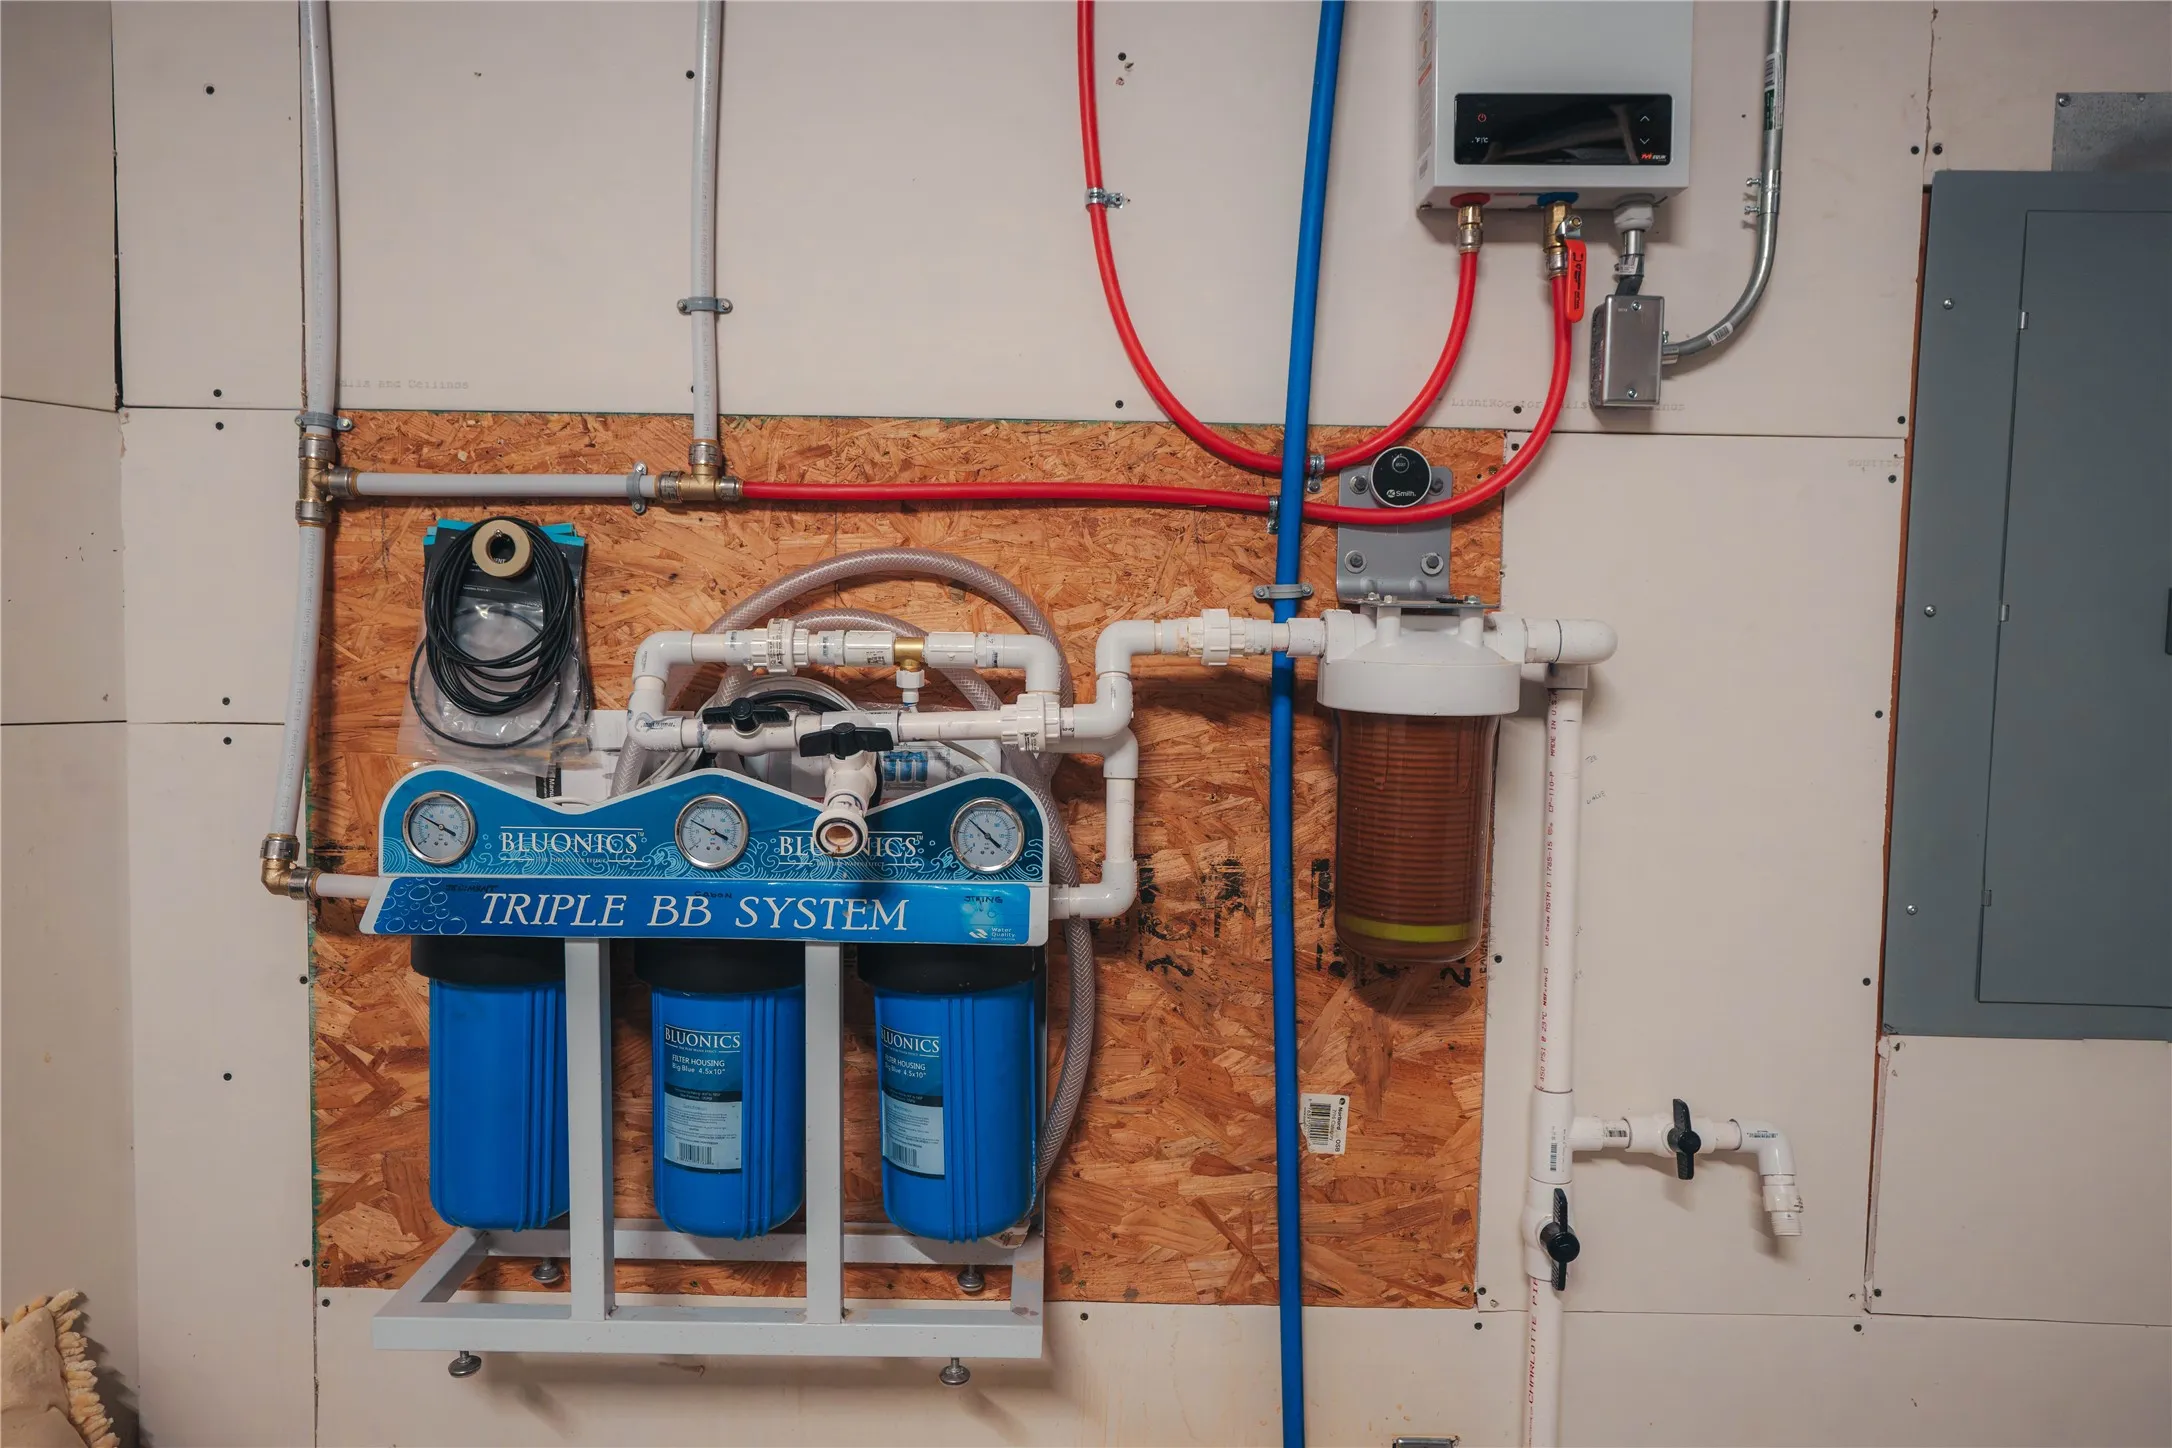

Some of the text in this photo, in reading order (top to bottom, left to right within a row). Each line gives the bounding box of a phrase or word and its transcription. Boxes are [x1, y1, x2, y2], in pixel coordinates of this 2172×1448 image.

[501, 832, 637, 855] BLUONICS
[481, 893, 909, 931] TRIPLE BB SYSTEM
[665, 1027, 740, 1048] BLUONICS
[672, 1053, 725, 1068] FILTER HOUSING
[672, 1063, 681, 1072] Big
[682, 1064, 695, 1074] Blue
[897, 1059, 926, 1071] HOUSING
[1528, 1315, 1537, 1404] CHARLOTTE
